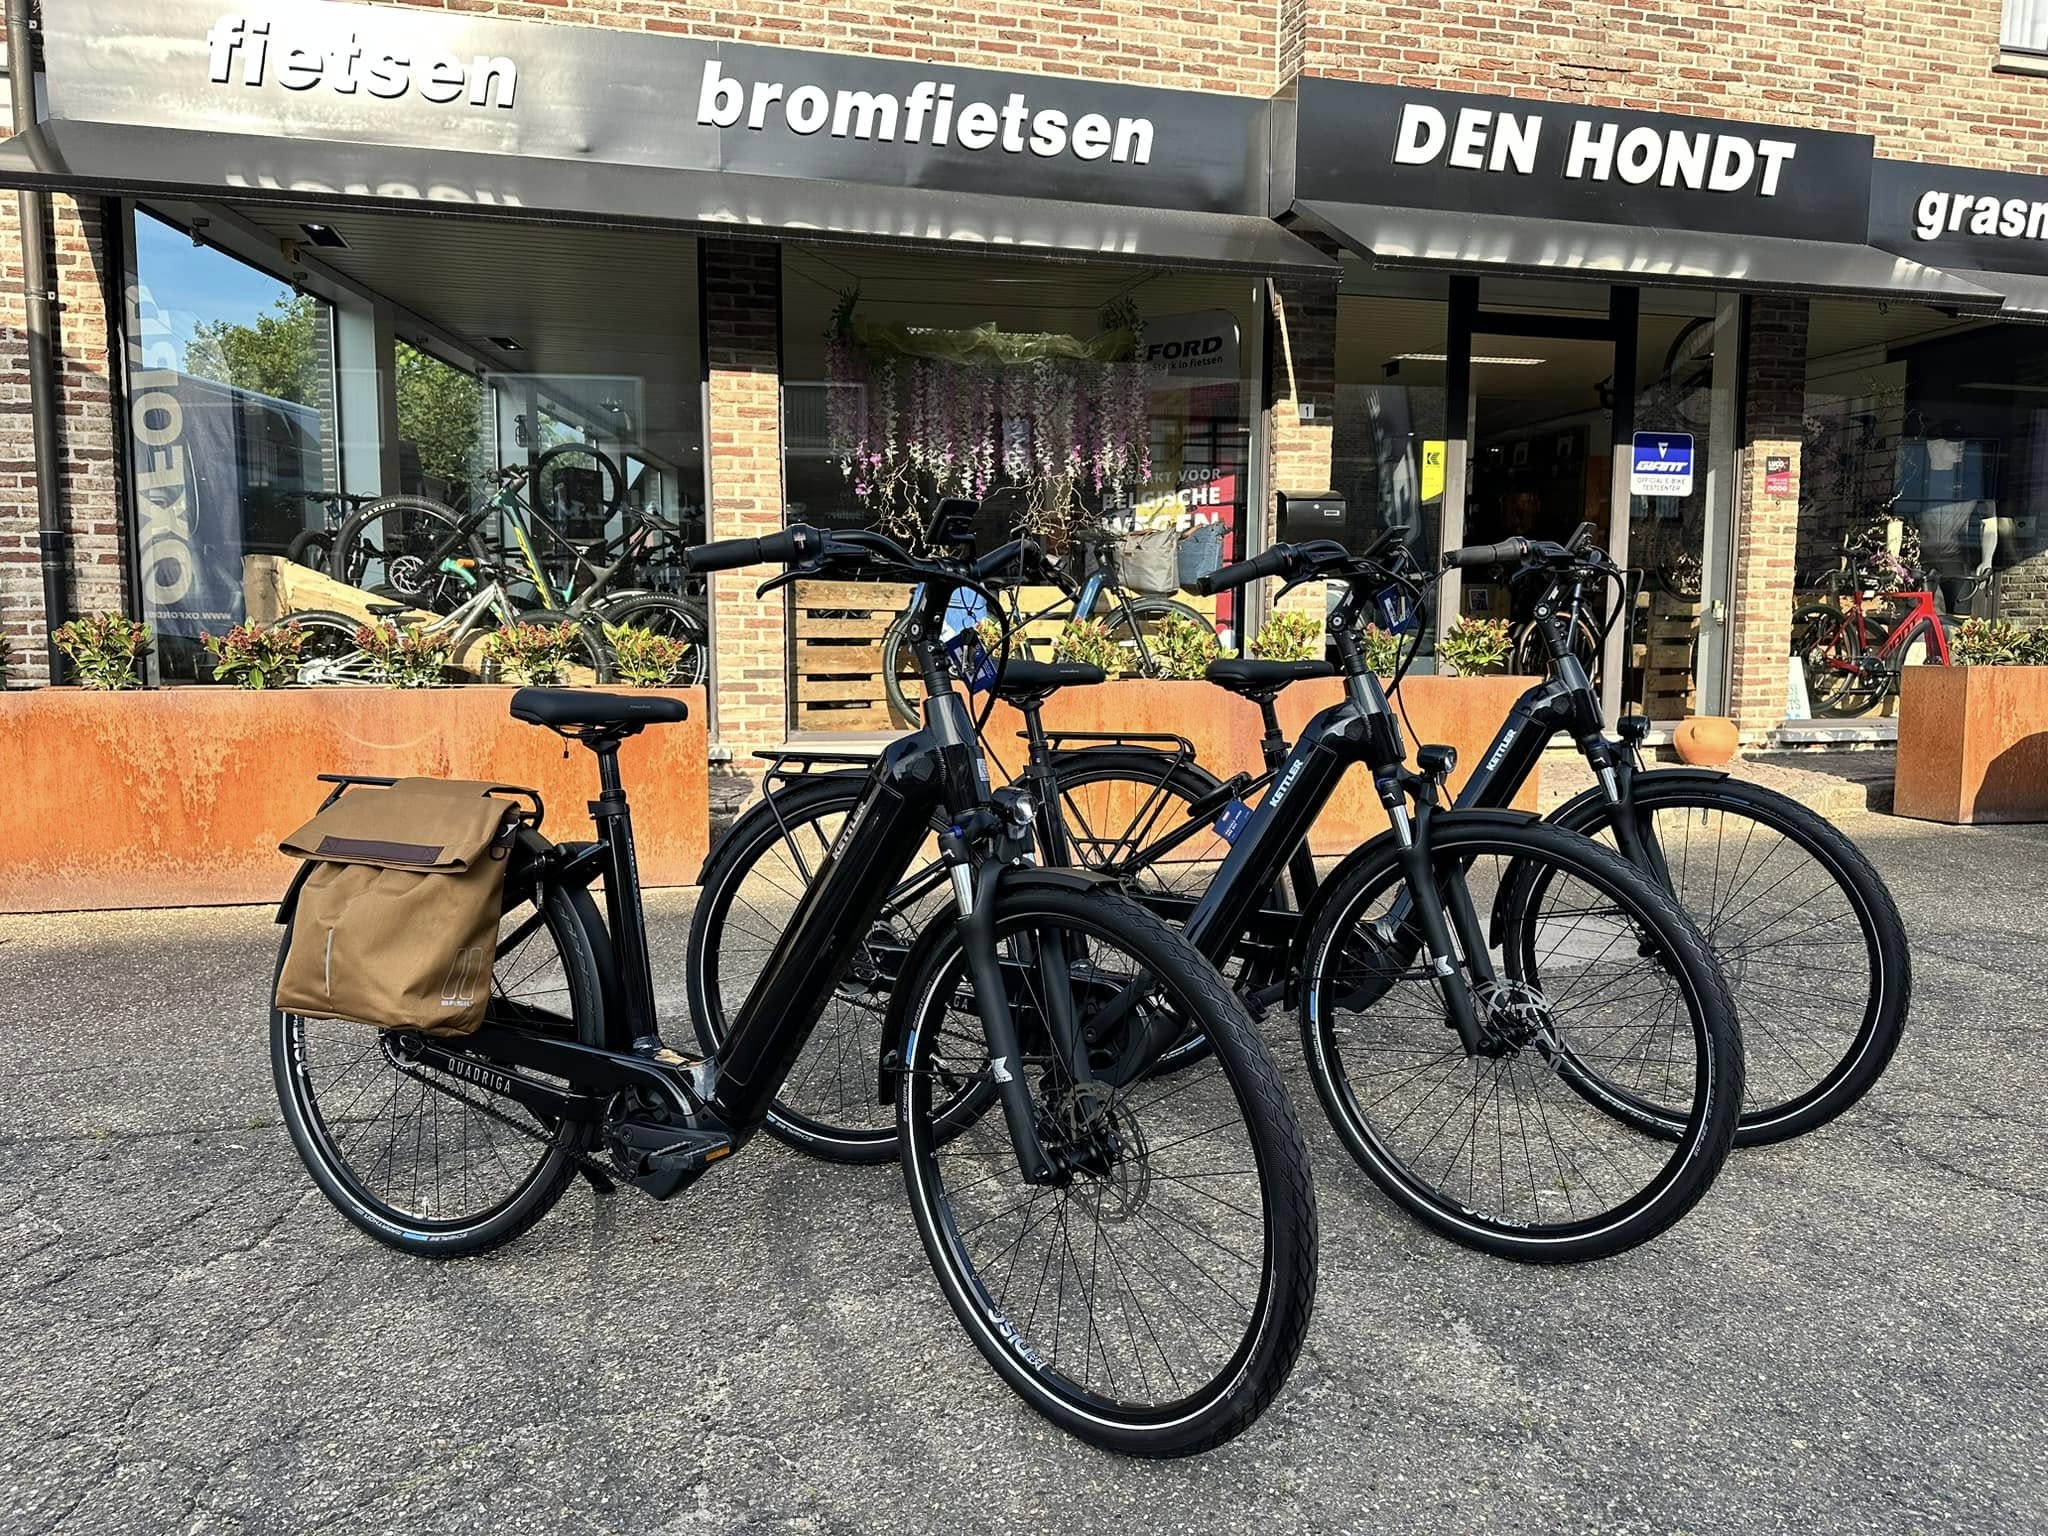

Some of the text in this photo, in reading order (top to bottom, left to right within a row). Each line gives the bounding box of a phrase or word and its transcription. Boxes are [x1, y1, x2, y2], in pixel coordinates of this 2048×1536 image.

[206, 16, 518, 108] fietsen
[697, 59, 1154, 164] bromfietsen
[1394, 103, 1797, 196] DEN HONDT
[1151, 361, 1177, 371] Stek
[1190, 355, 1223, 368] fietsen
[1103, 468, 1221, 487] GMAAKT VOOR
[1635, 460, 1689, 472] GIANT
[1102, 486, 1221, 509] BELGISCHE
[1485, 728, 1517, 770] KETTLER
[1269, 759, 1304, 807] KETTLER
[831, 801, 866, 860] KETTLER
[448, 1057, 512, 1094] QUADRIGA
